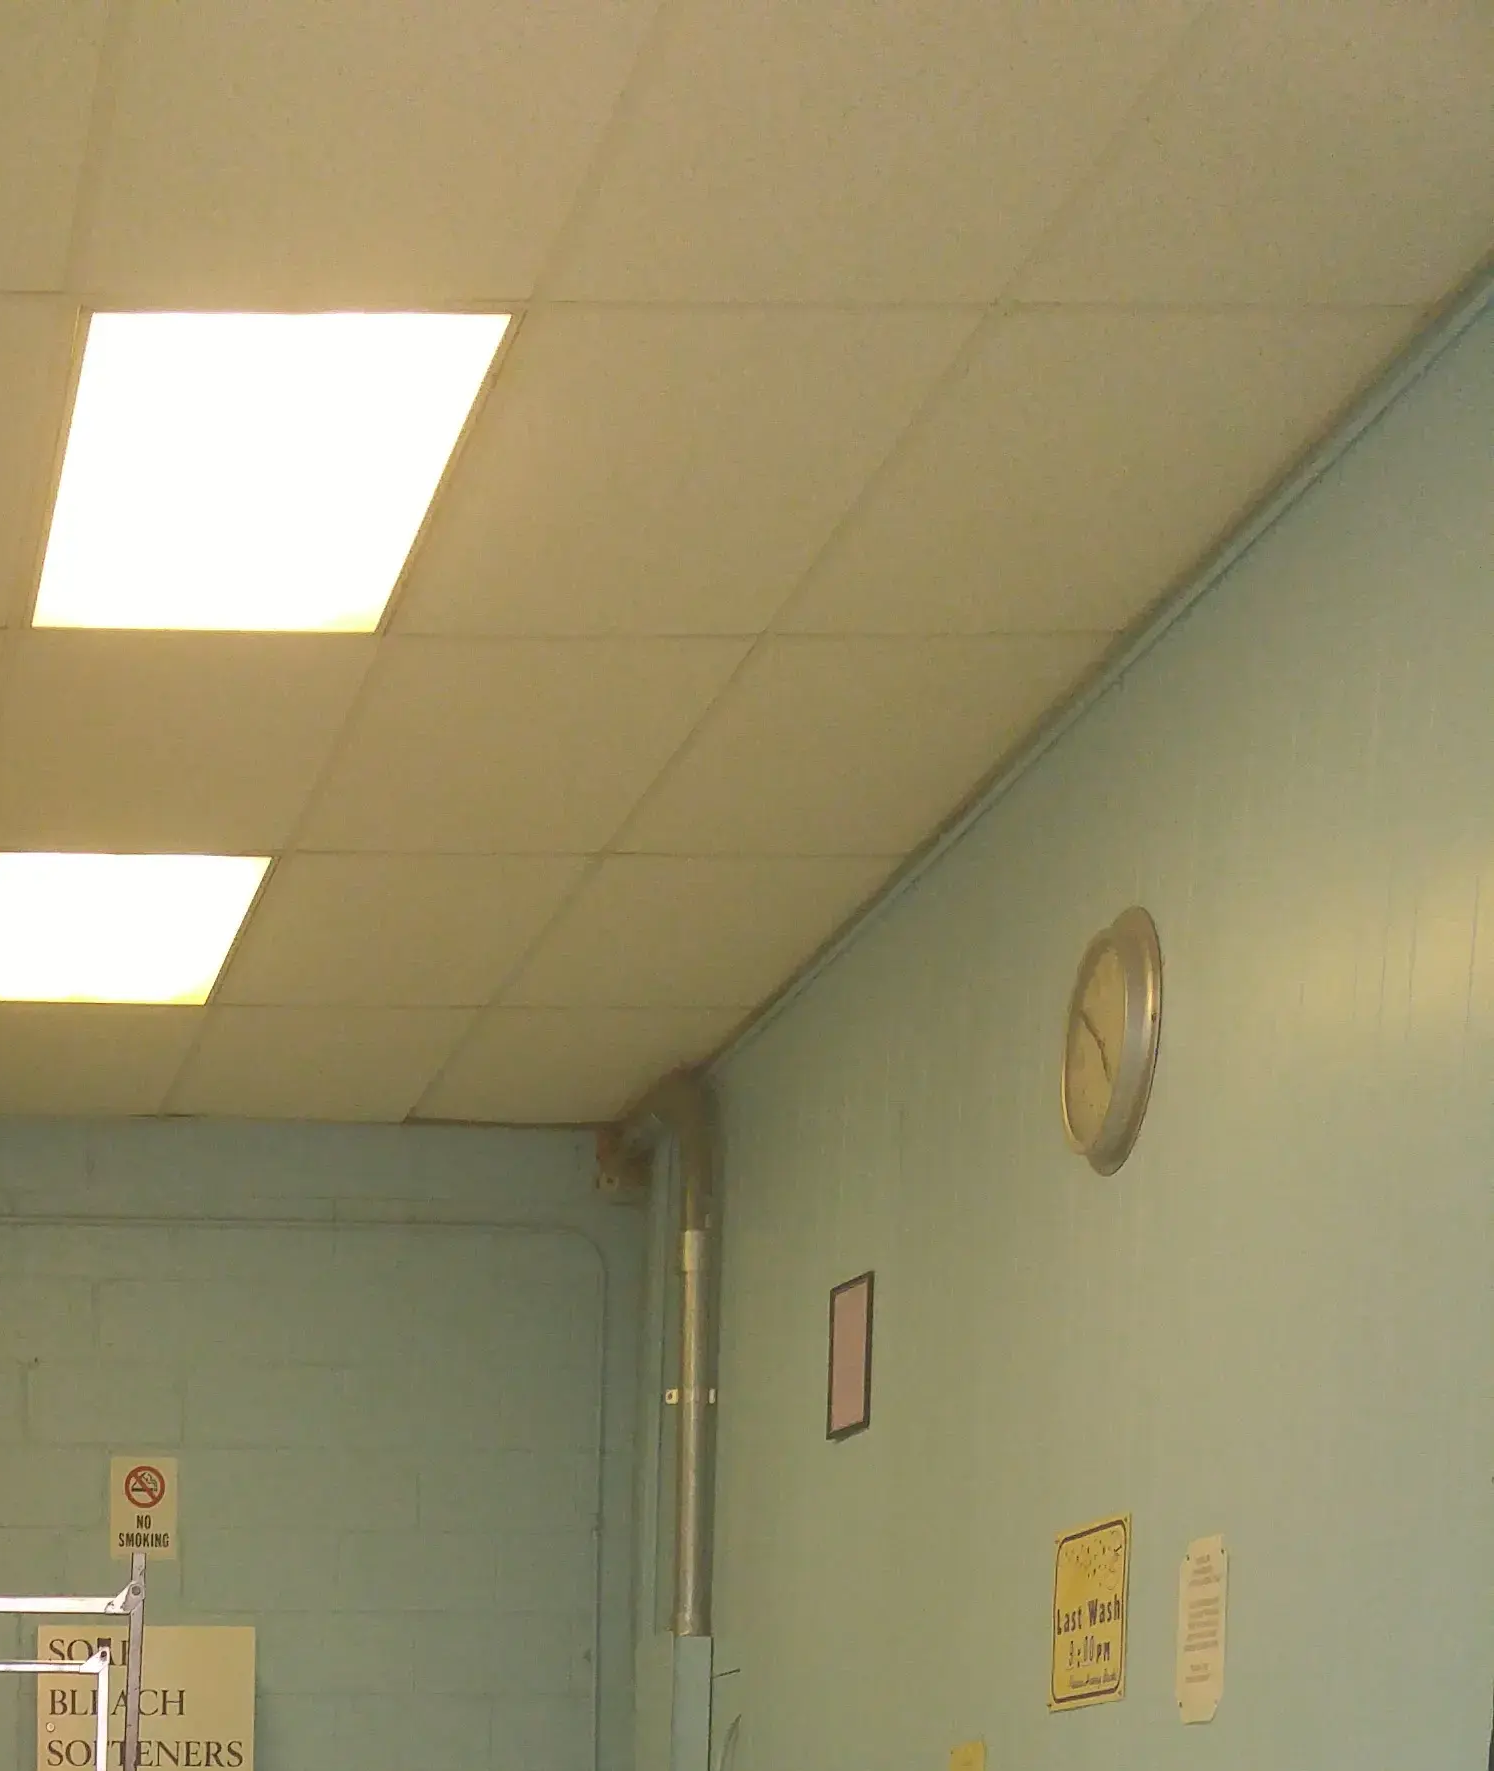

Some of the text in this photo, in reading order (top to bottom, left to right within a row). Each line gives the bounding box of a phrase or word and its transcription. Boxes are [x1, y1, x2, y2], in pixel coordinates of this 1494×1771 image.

[136, 1514, 152, 1529] NO
[118, 1532, 170, 1548] SMOKING
[1057, 1593, 1120, 1635] Last Wash
[47, 1739, 244, 1768] SOTENERS
